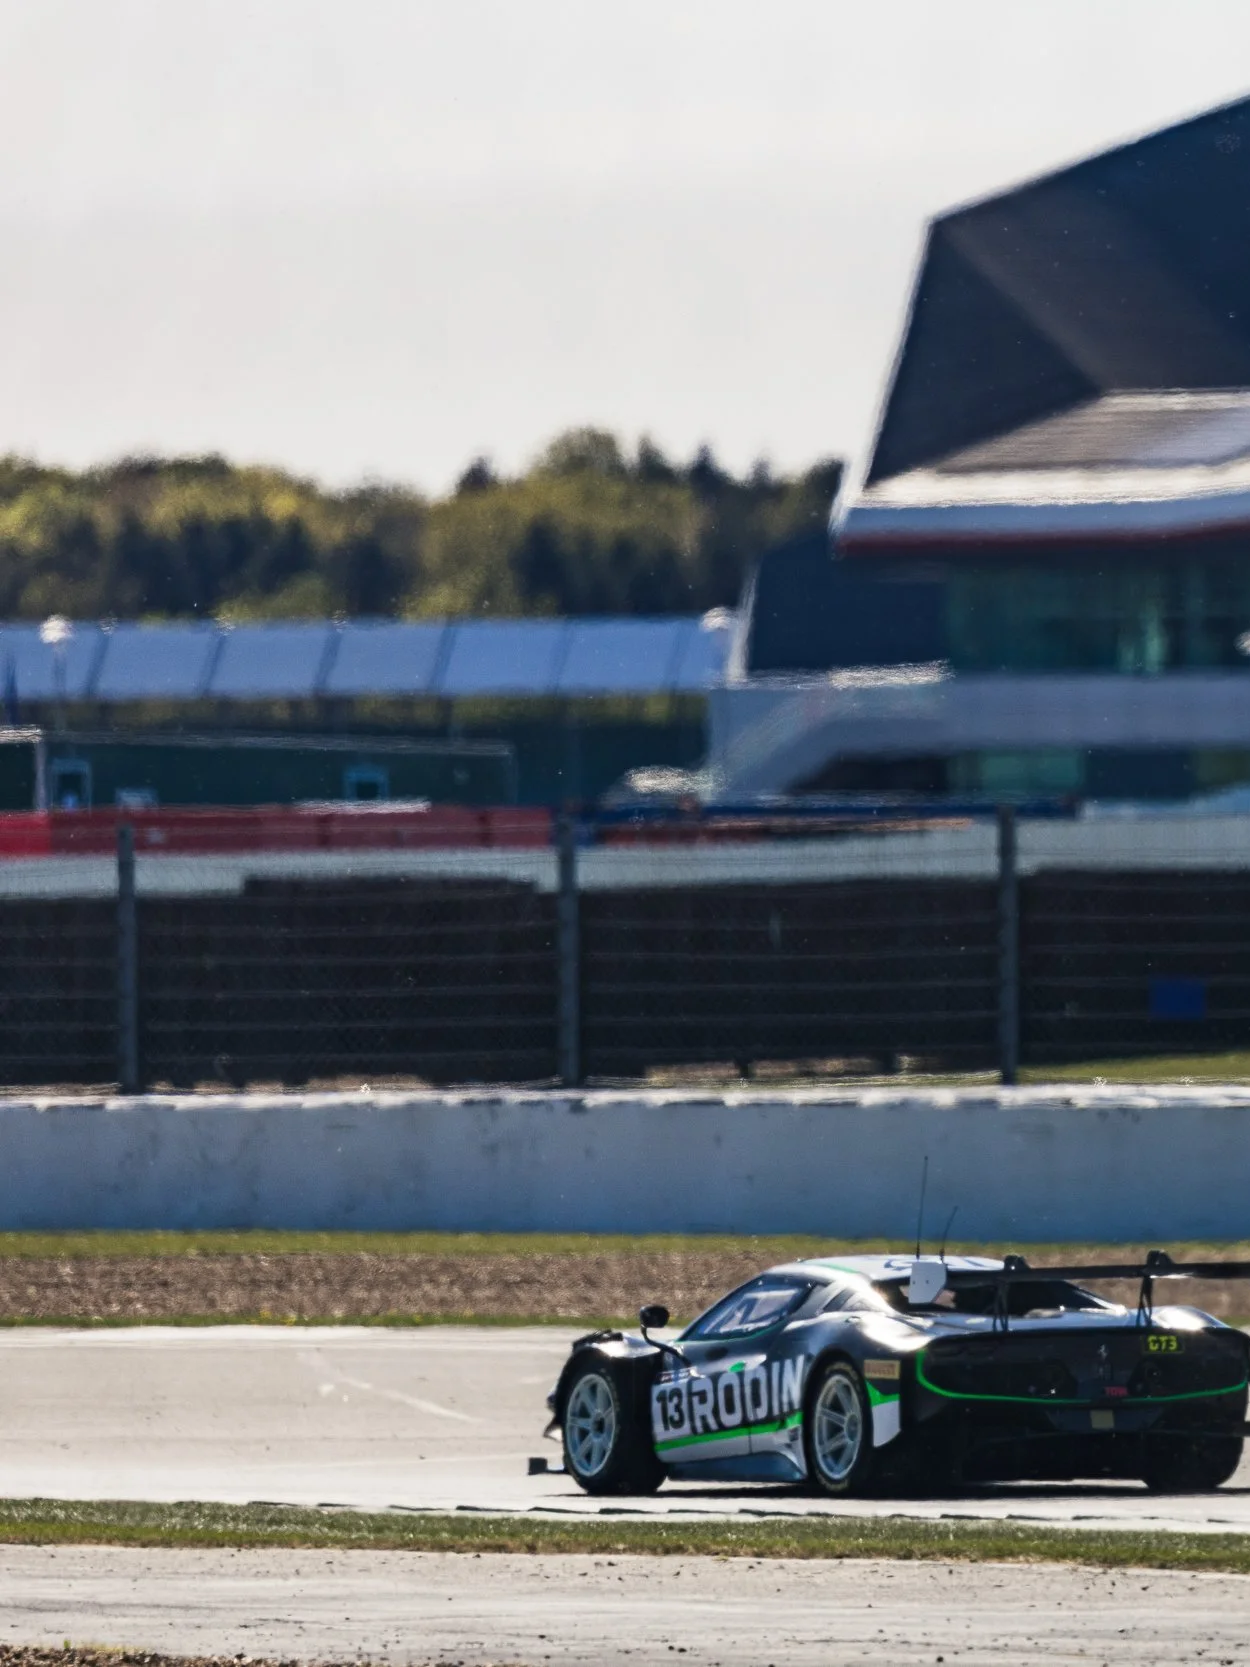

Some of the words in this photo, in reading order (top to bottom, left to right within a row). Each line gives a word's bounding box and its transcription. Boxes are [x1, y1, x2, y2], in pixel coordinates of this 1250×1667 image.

[1147, 1335, 1177, 1351] GT3
[656, 1388, 686, 1431] 13
[691, 1355, 805, 1434] RODIN
